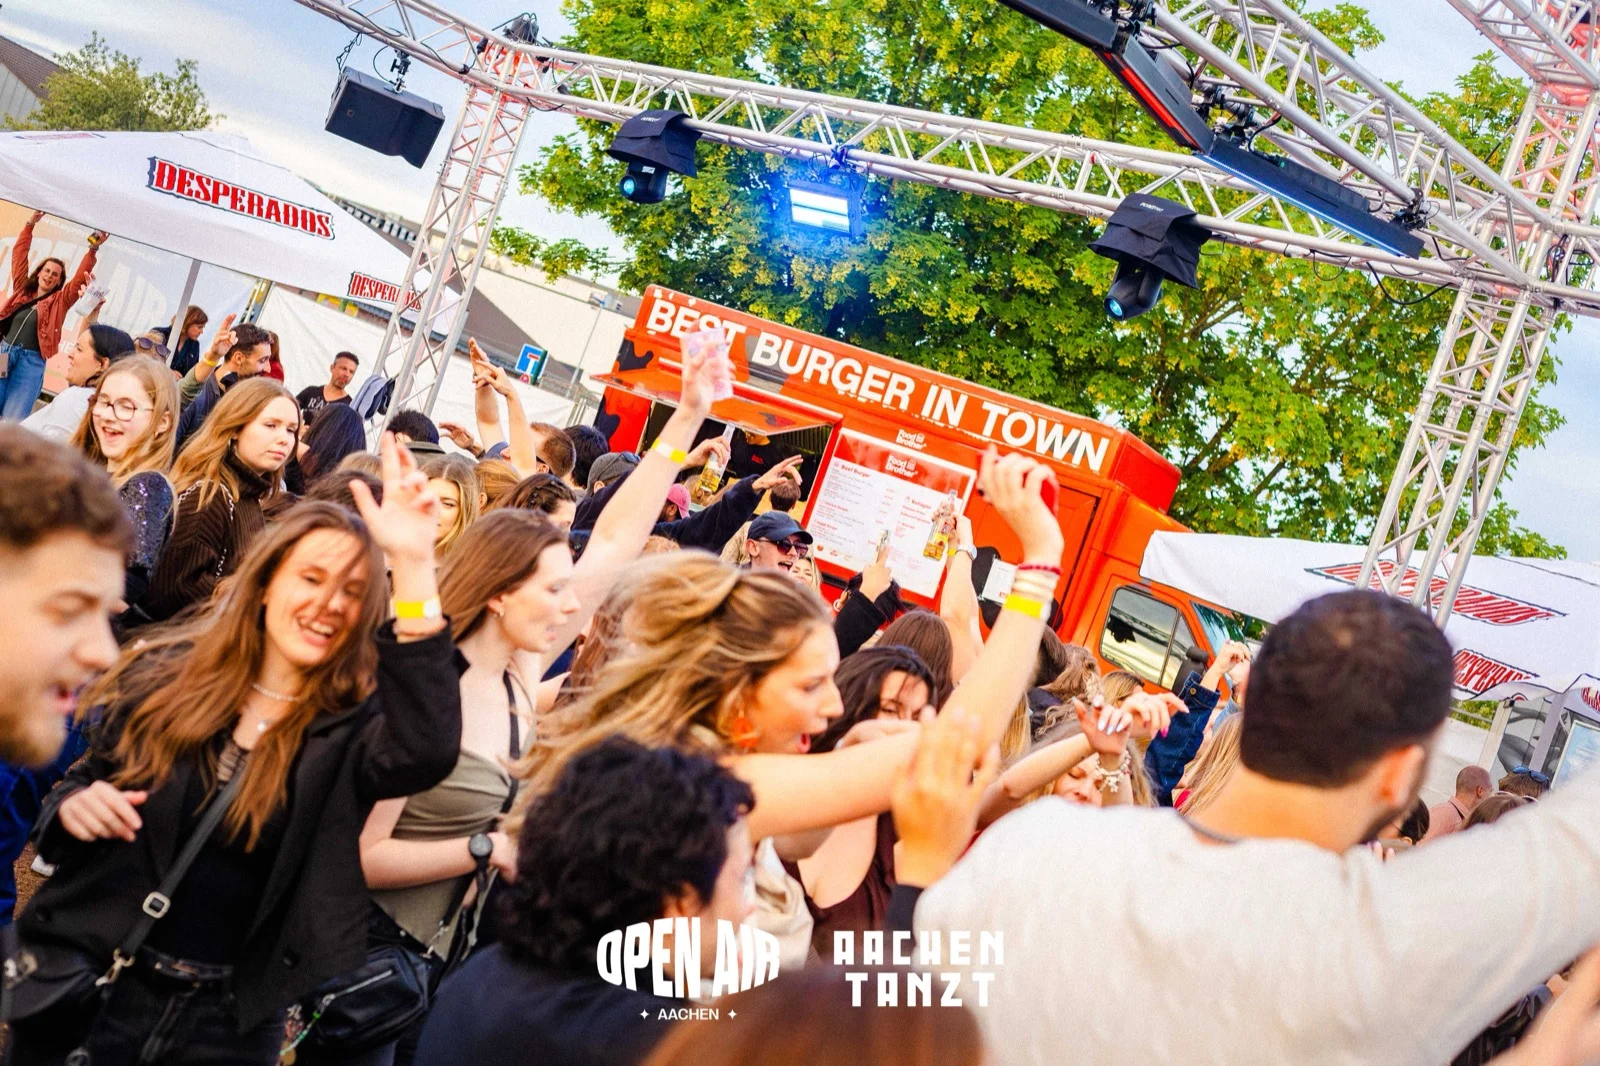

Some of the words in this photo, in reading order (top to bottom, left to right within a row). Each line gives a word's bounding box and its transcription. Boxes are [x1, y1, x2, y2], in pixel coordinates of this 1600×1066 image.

[154, 159, 331, 238] DESPERADOS
[349, 273, 424, 310] DESPERDOS
[751, 332, 916, 411] BURGER
[921, 384, 968, 427] IN
[981, 401, 1110, 472] TOWN
[896, 429, 917, 443] Food
[888, 455, 908, 469] Food
[1453, 650, 1532, 693] DESPERA
